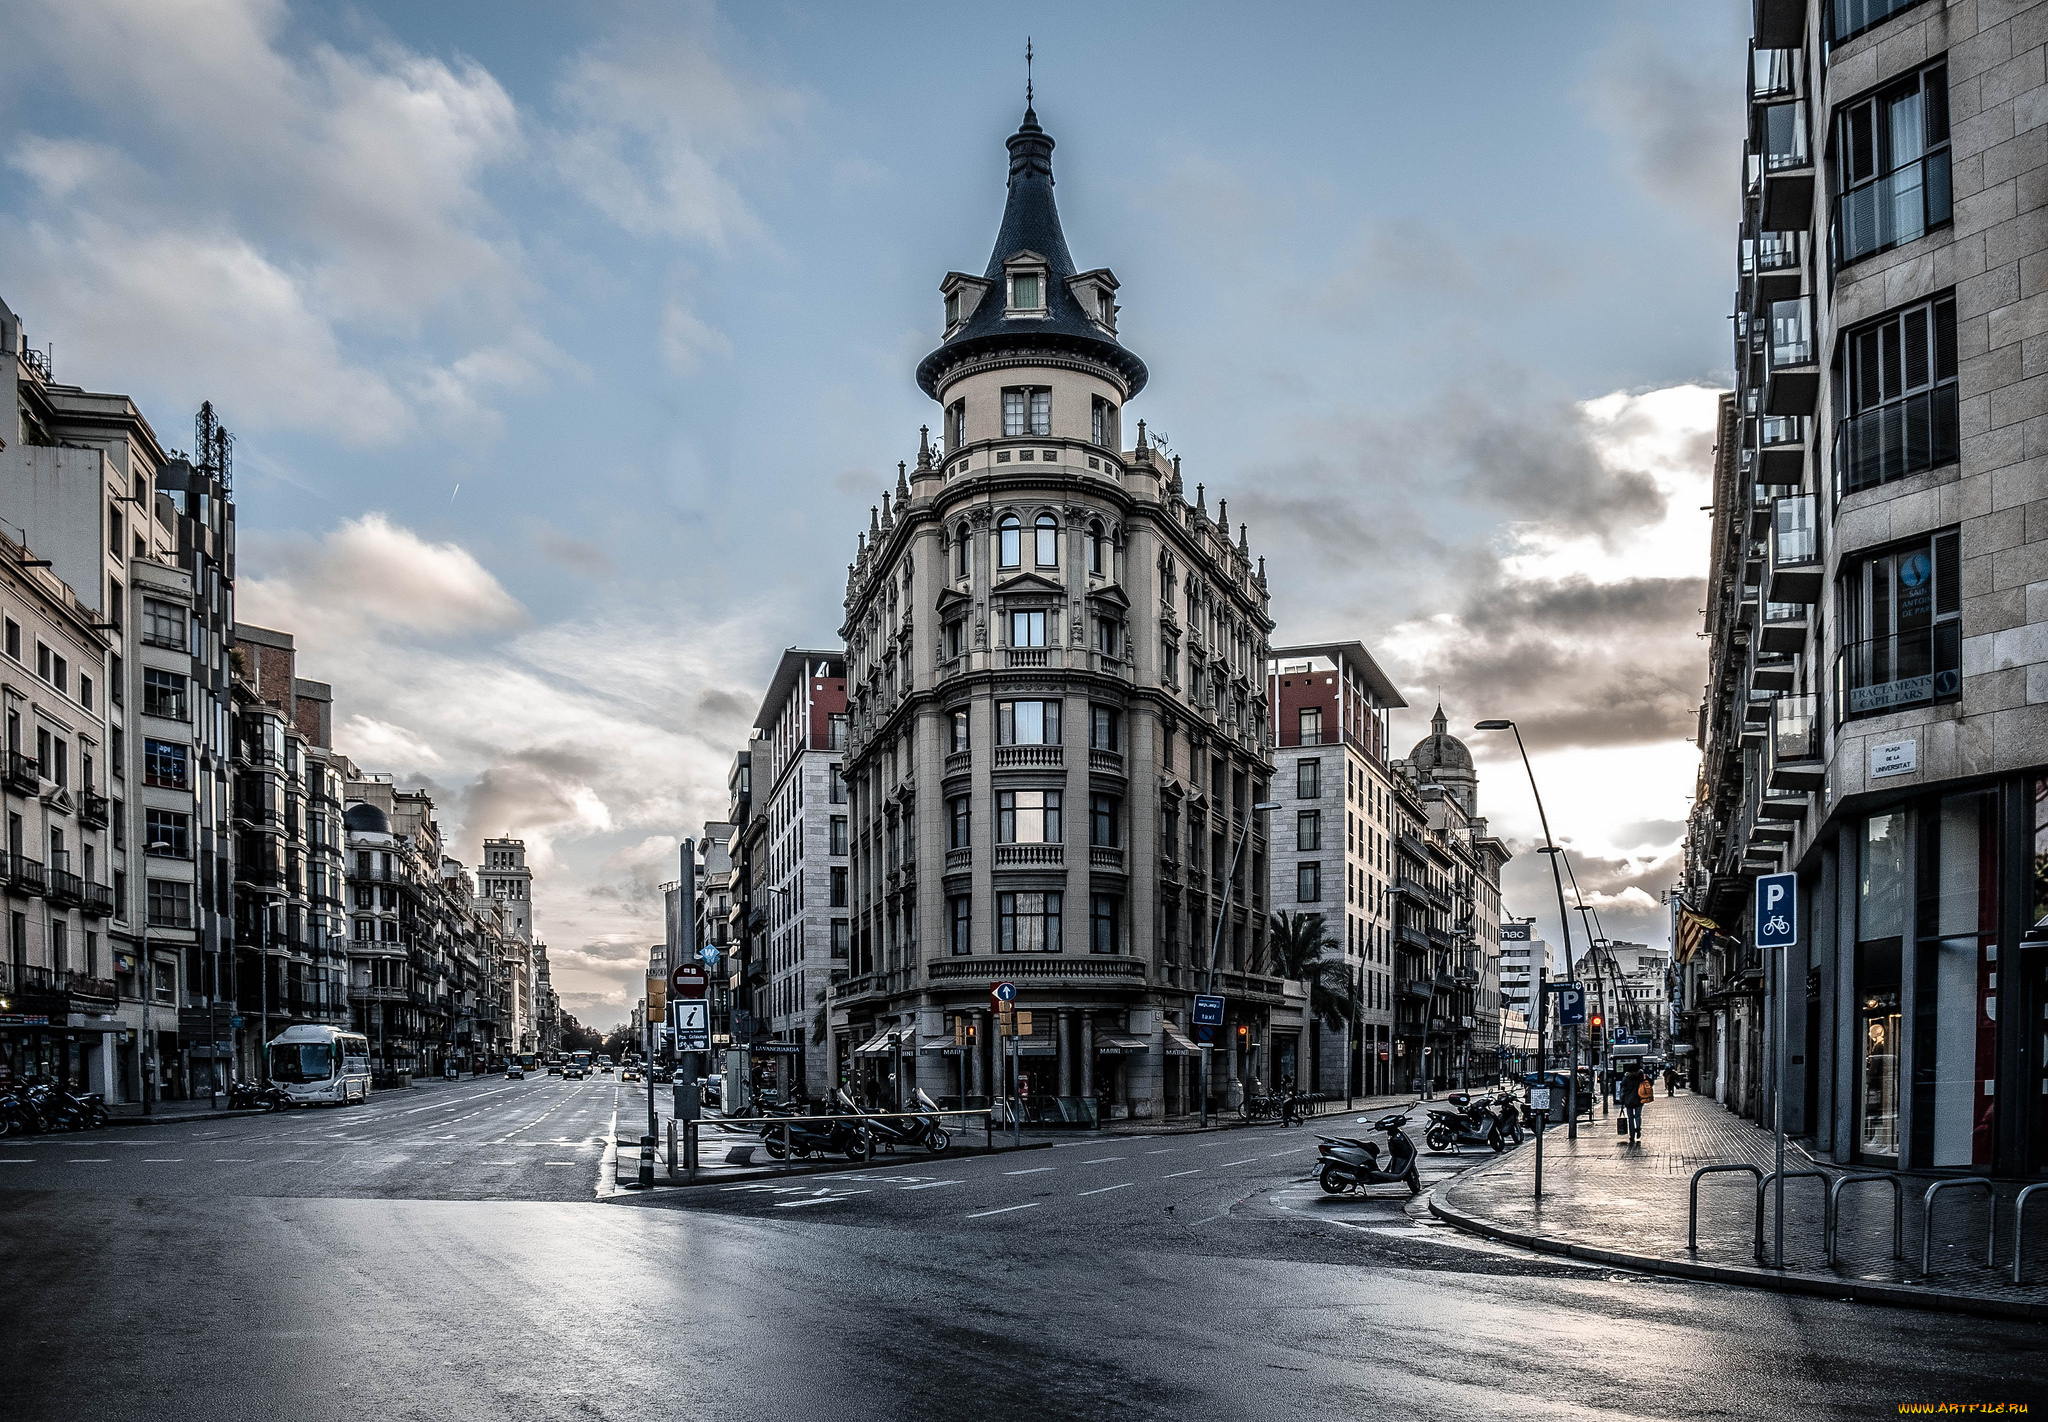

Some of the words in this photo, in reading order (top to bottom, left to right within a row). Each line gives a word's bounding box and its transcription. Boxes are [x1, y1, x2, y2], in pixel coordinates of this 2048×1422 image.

[1902, 609, 1913, 618] DE
[1851, 677, 1932, 700] TRACTAMENTS
[1875, 761, 1911, 773] UNIVERSITAT
[1766, 884, 1784, 911] P
[1563, 990, 1579, 1011] P
[1617, 1029, 1624, 1038] P
